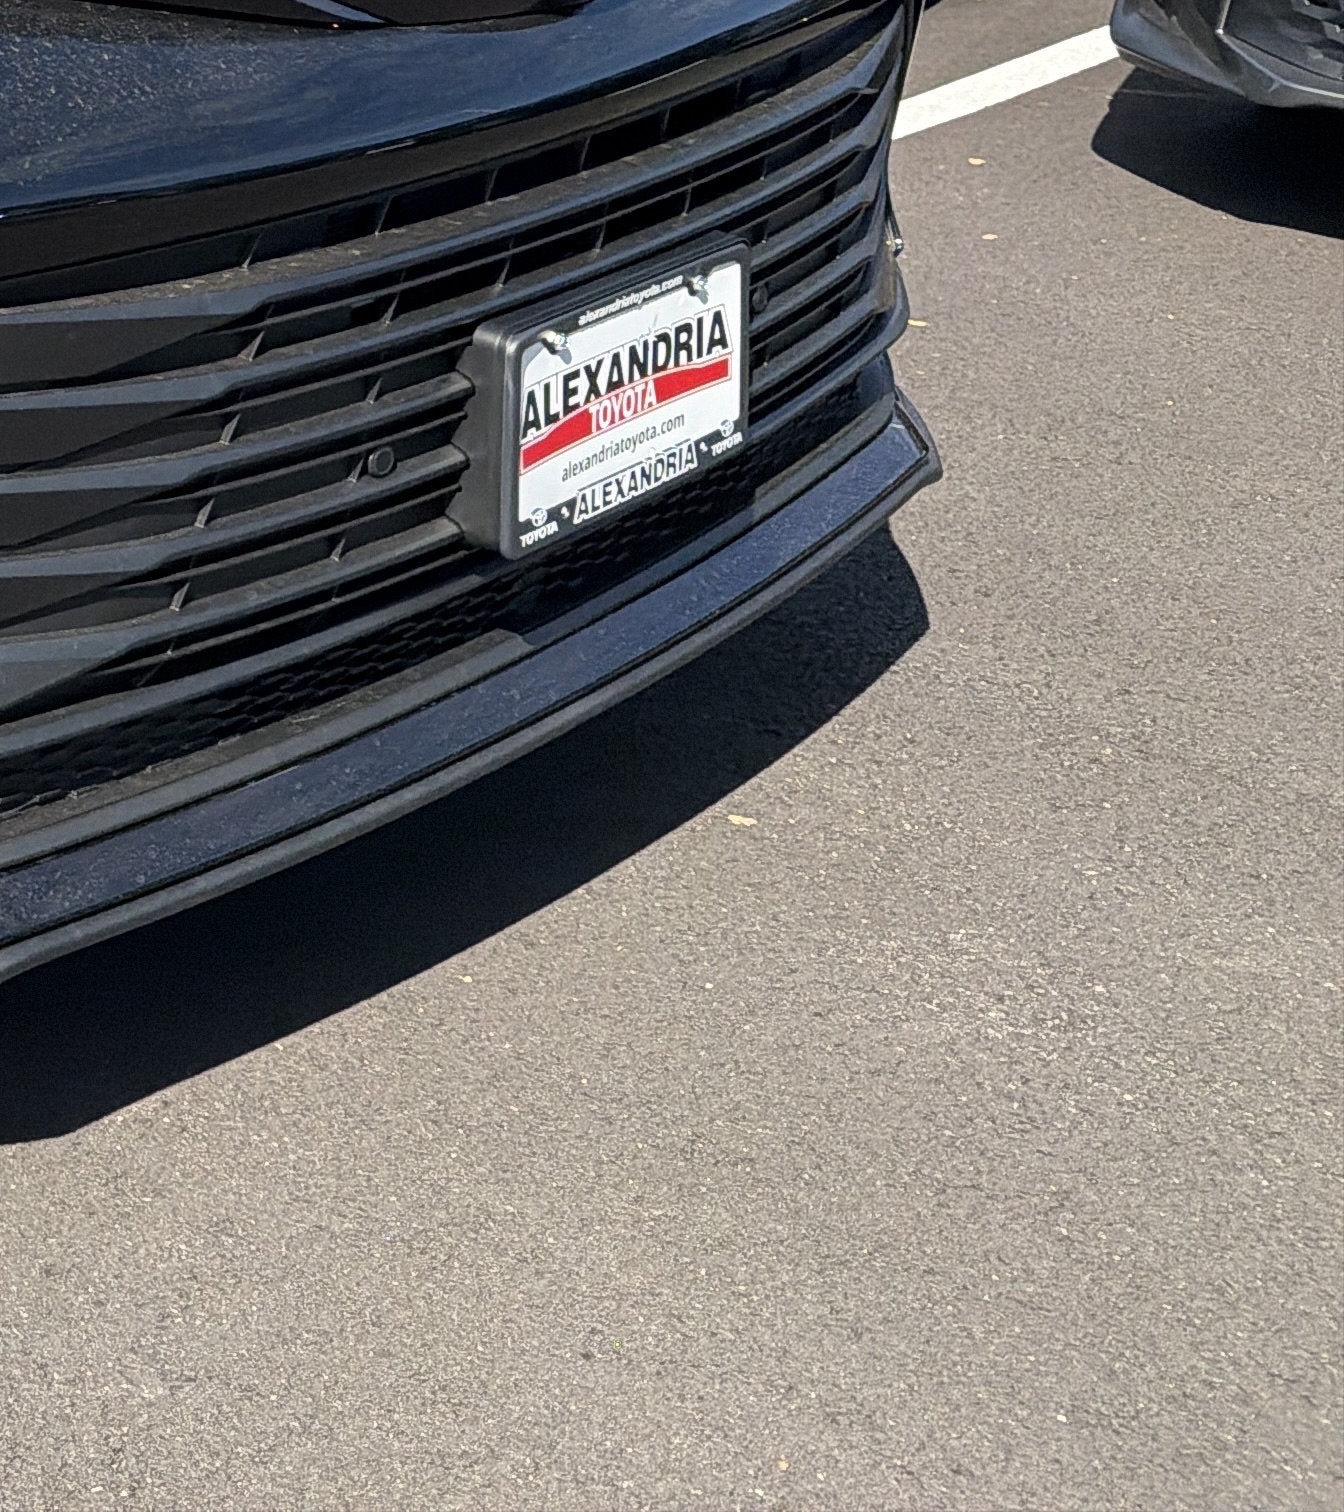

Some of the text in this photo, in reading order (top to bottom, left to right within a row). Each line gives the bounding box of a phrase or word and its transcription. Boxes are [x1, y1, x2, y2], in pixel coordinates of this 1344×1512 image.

[578, 274, 684, 326] alexandriatoyota.com
[523, 309, 729, 439] ALEXANDRIA
[588, 380, 658, 433] TOYOTA
[562, 413, 685, 483] alexandriatoyota.com
[711, 431, 743, 457] TOYOTA
[574, 441, 697, 522] ALEXANDRIA
[519, 522, 559, 548] TOYOTA
